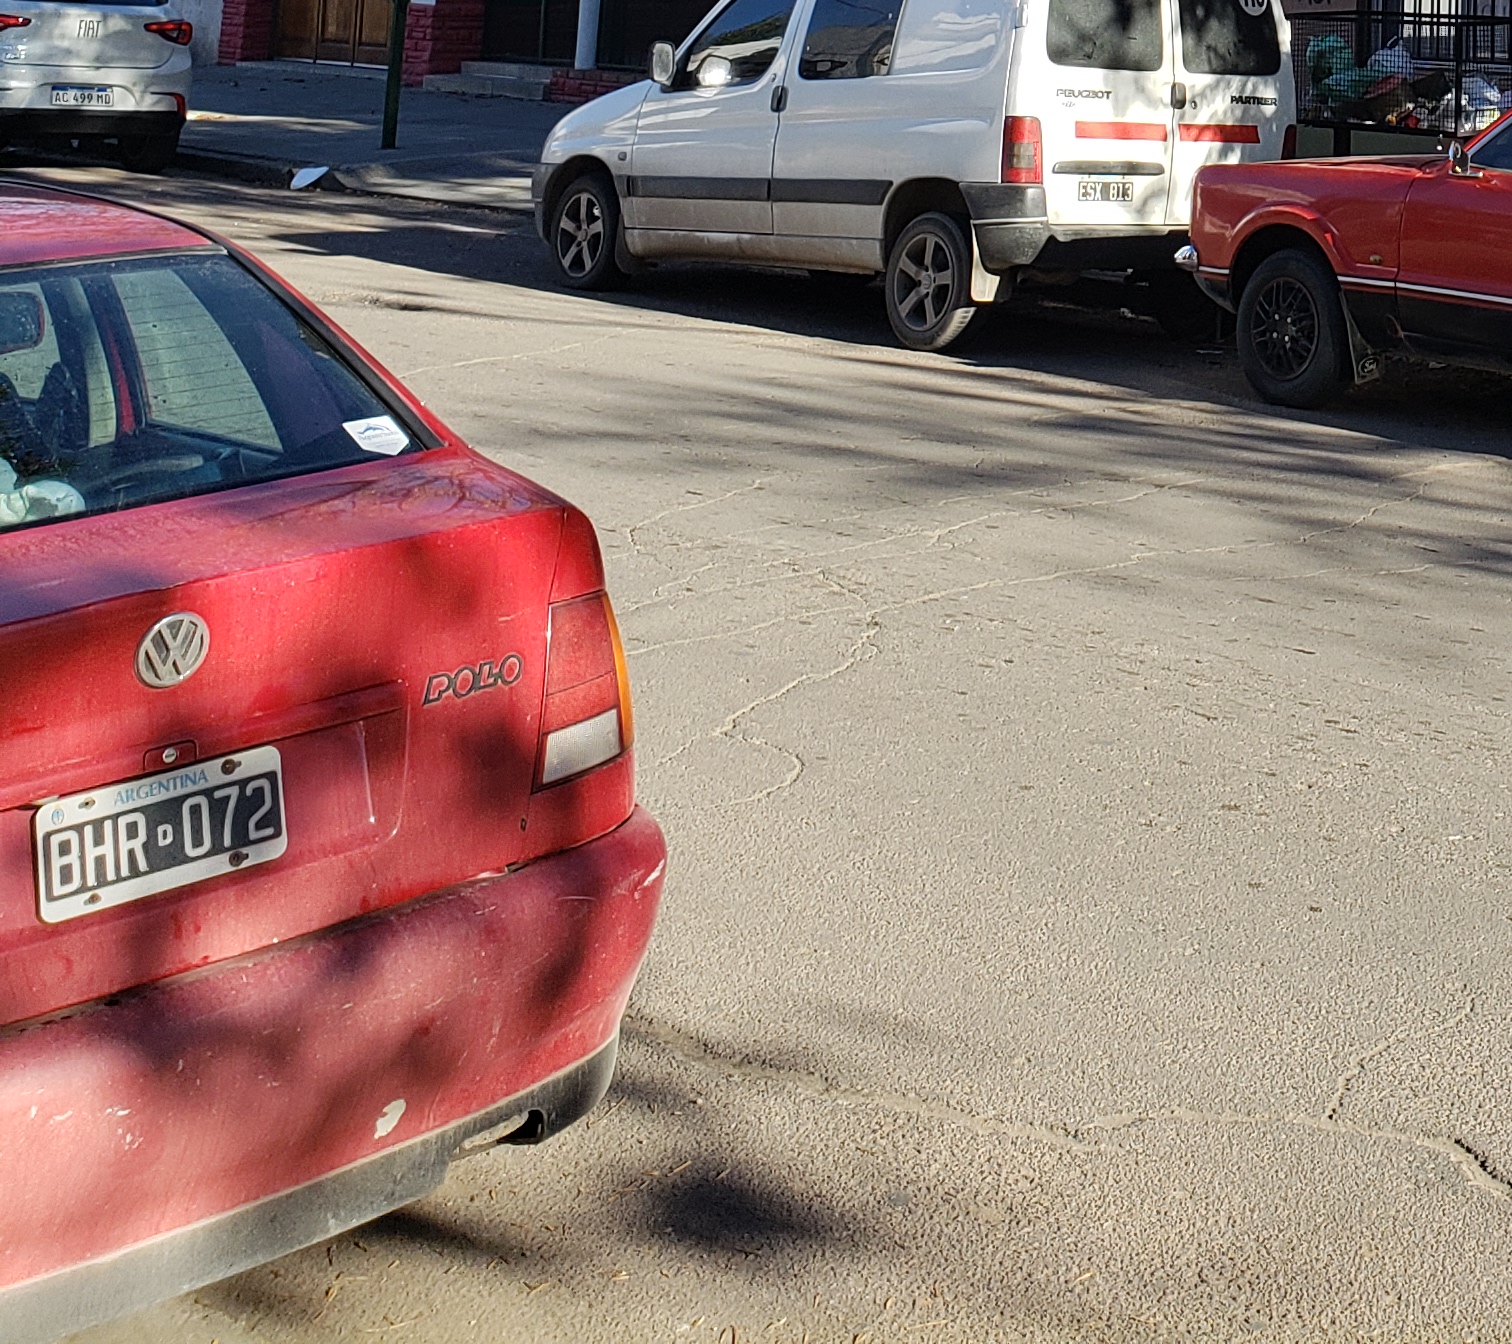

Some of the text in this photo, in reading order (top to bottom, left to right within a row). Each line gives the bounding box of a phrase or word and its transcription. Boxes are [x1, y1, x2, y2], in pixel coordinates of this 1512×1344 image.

[77, 19, 102, 38] FIAT
[54, 91, 111, 105] AC 499 MD
[1056, 88, 1113, 100] PEUGEOT
[1230, 94, 1278, 107] PARTNER
[1079, 182, 1133, 202] ESX 813
[422, 653, 523, 707] POLO
[113, 768, 210, 806] ARGENTINA
[49, 777, 275, 897] BHR D 072
